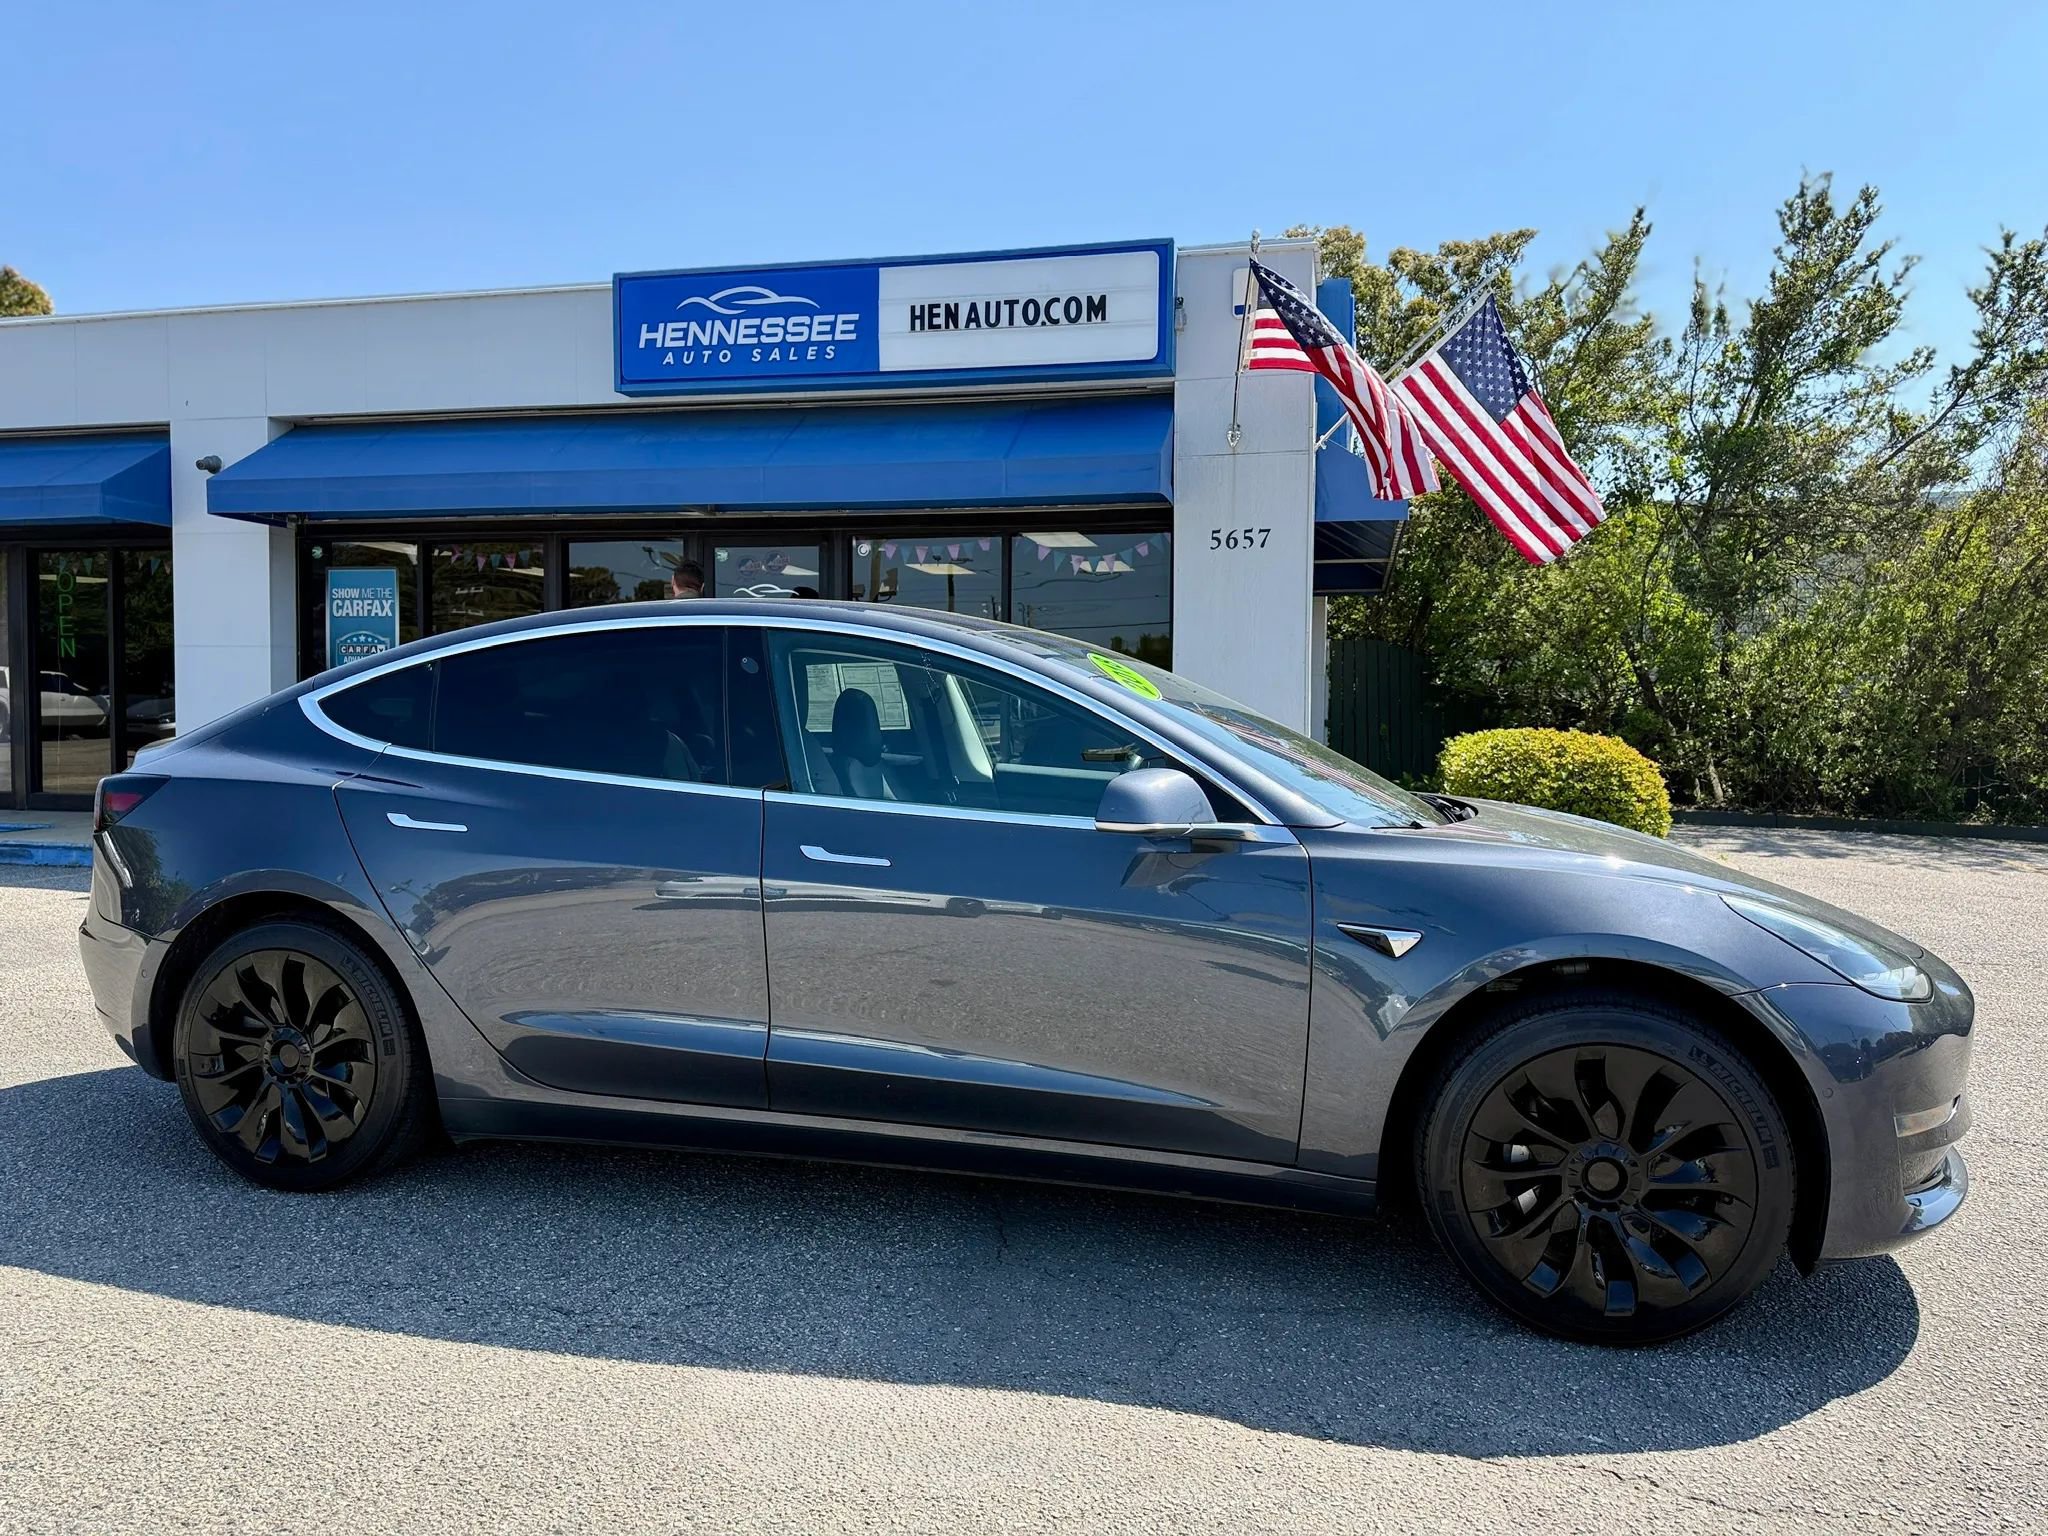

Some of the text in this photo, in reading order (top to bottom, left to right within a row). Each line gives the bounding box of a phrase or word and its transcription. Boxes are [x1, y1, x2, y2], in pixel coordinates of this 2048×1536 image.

[910, 294, 1107, 331] HENAUTO.COM
[639, 313, 859, 349] HENNESSEE
[663, 345, 835, 365] AUTO SALES
[1210, 527, 1271, 550] 5657
[332, 588, 392, 599] SHOW ME THE
[58, 571, 75, 658] OPEN
[332, 600, 393, 617] CARFAX
[1709, 1063, 1774, 1145] MICHELIN
